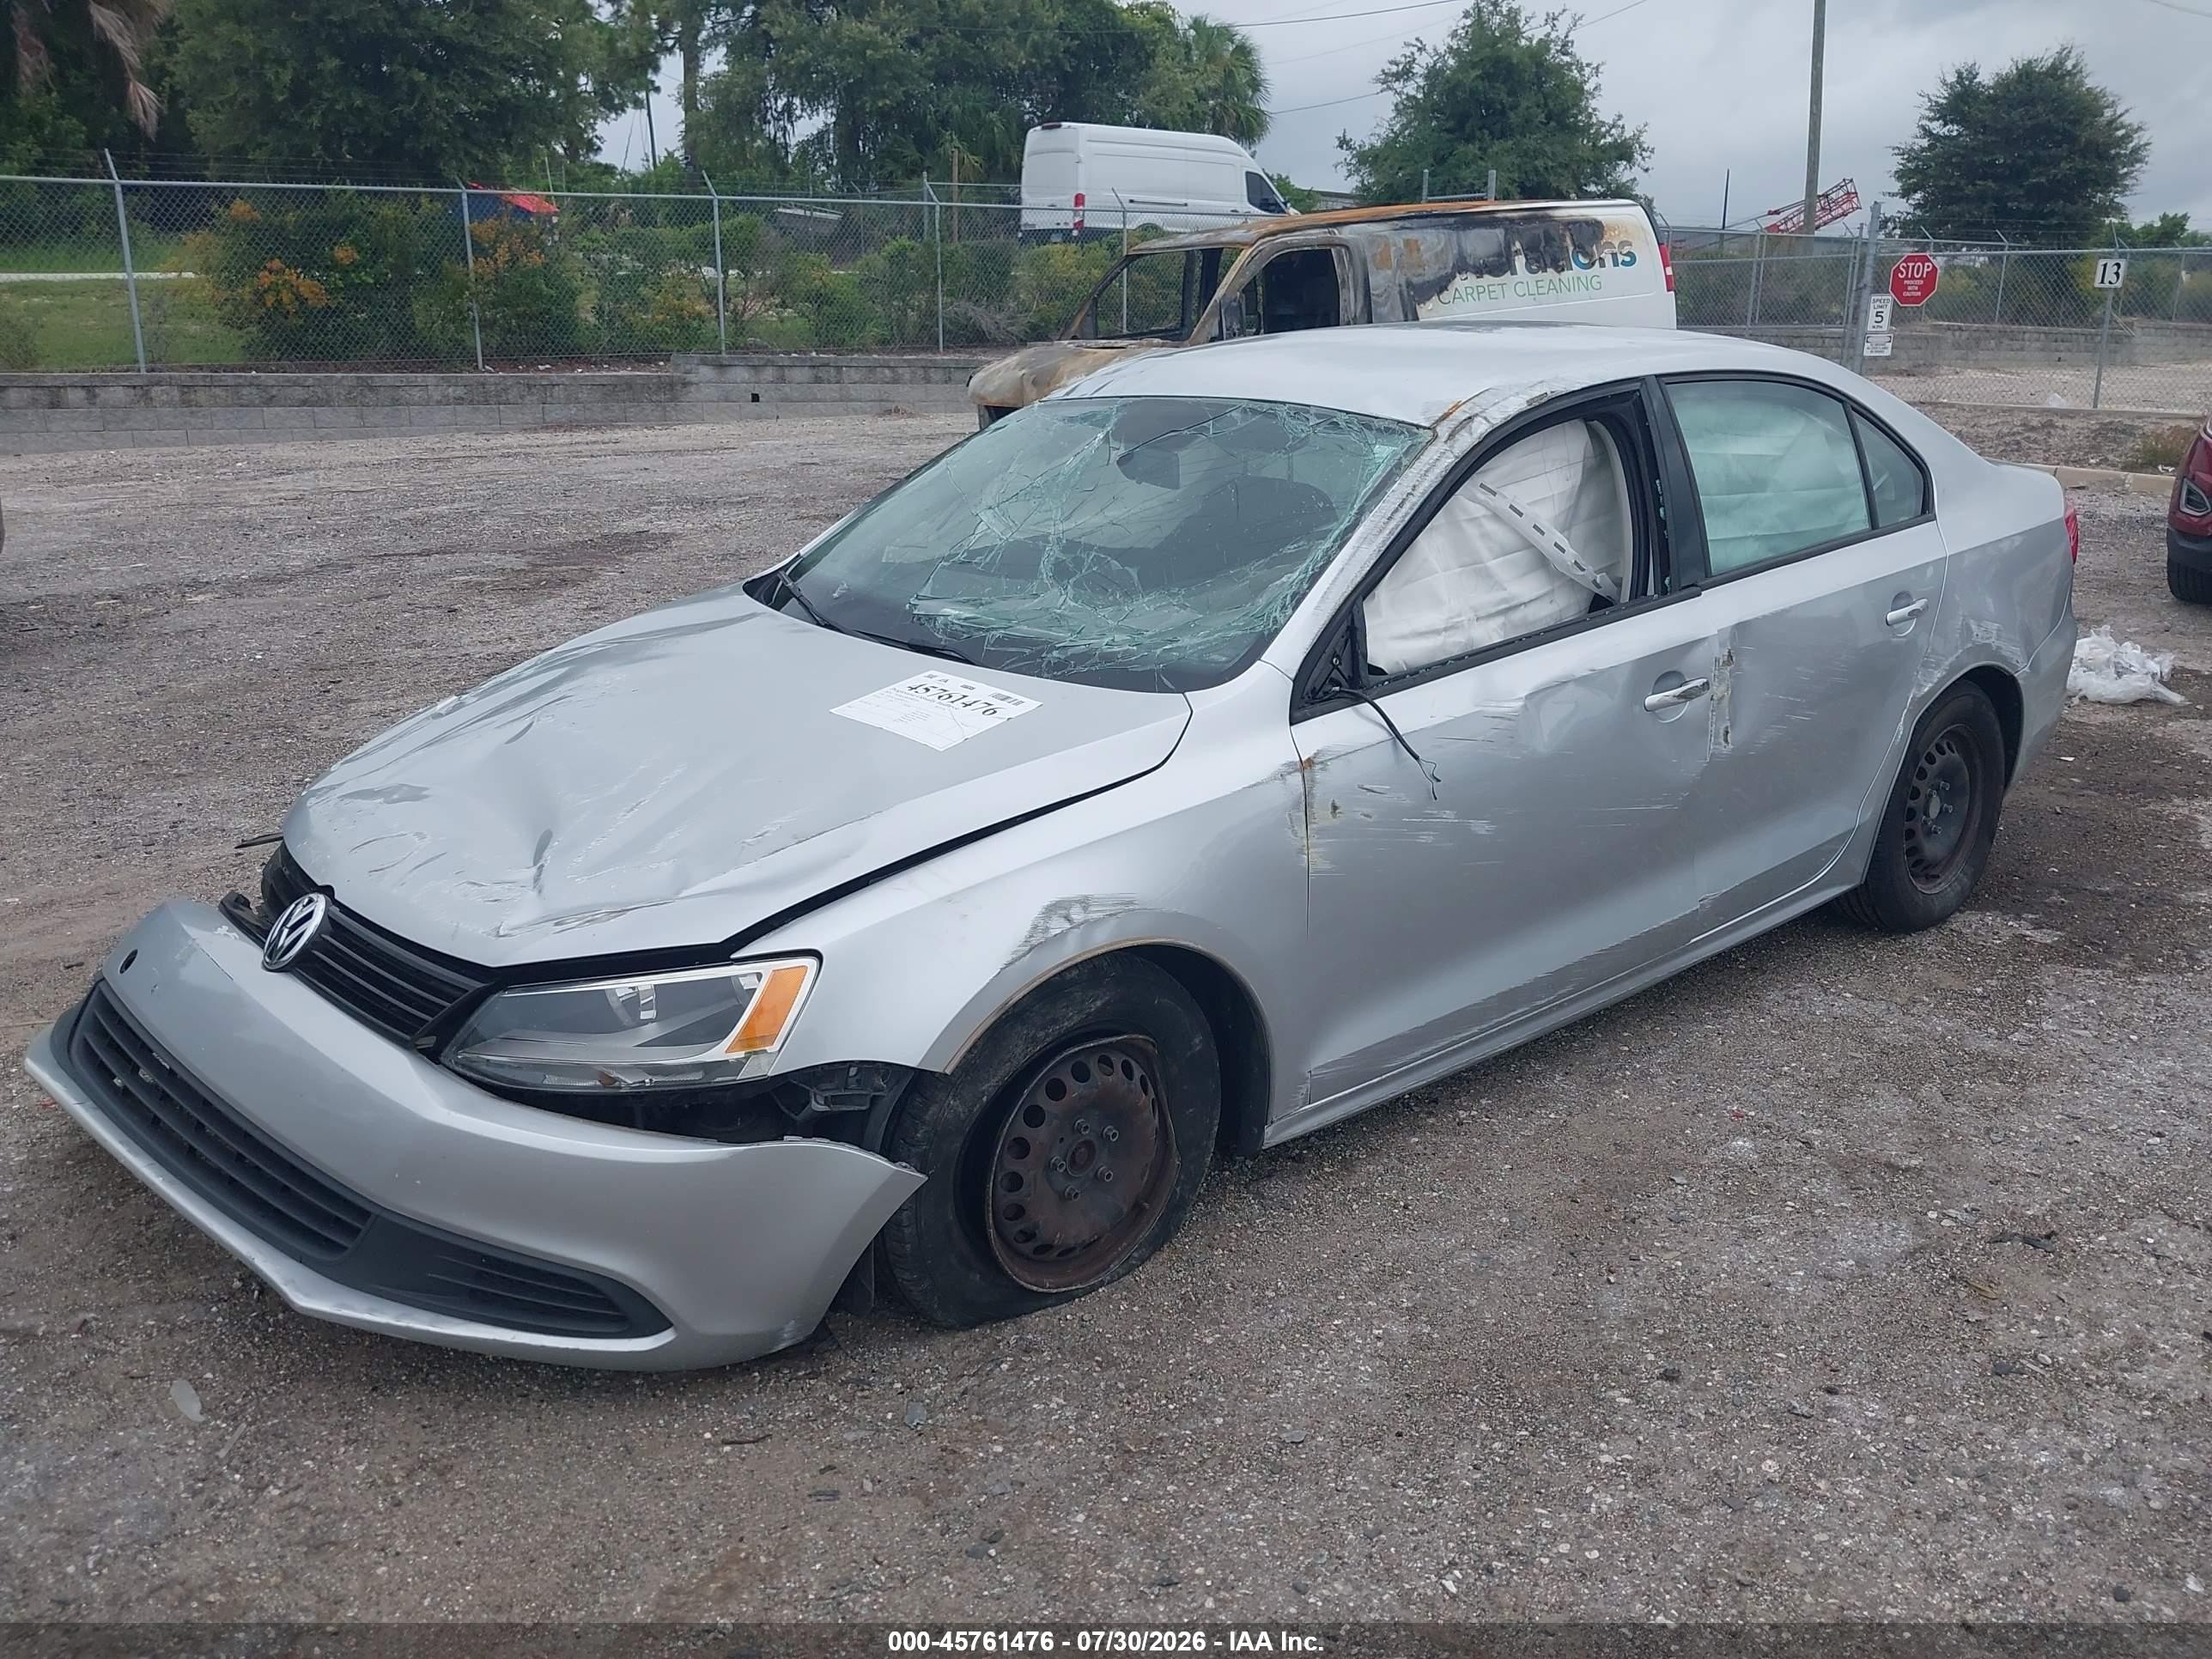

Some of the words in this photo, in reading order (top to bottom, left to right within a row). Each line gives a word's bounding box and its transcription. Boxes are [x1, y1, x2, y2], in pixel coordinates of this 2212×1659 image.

[1898, 262, 1933, 278] STOP
[2098, 262, 2121, 284] 13
[1437, 283, 1508, 306] CARPET
[1514, 274, 1602, 297] CLEANING
[1874, 311, 1884, 324] 5
[907, 684, 1006, 715] 45761476
